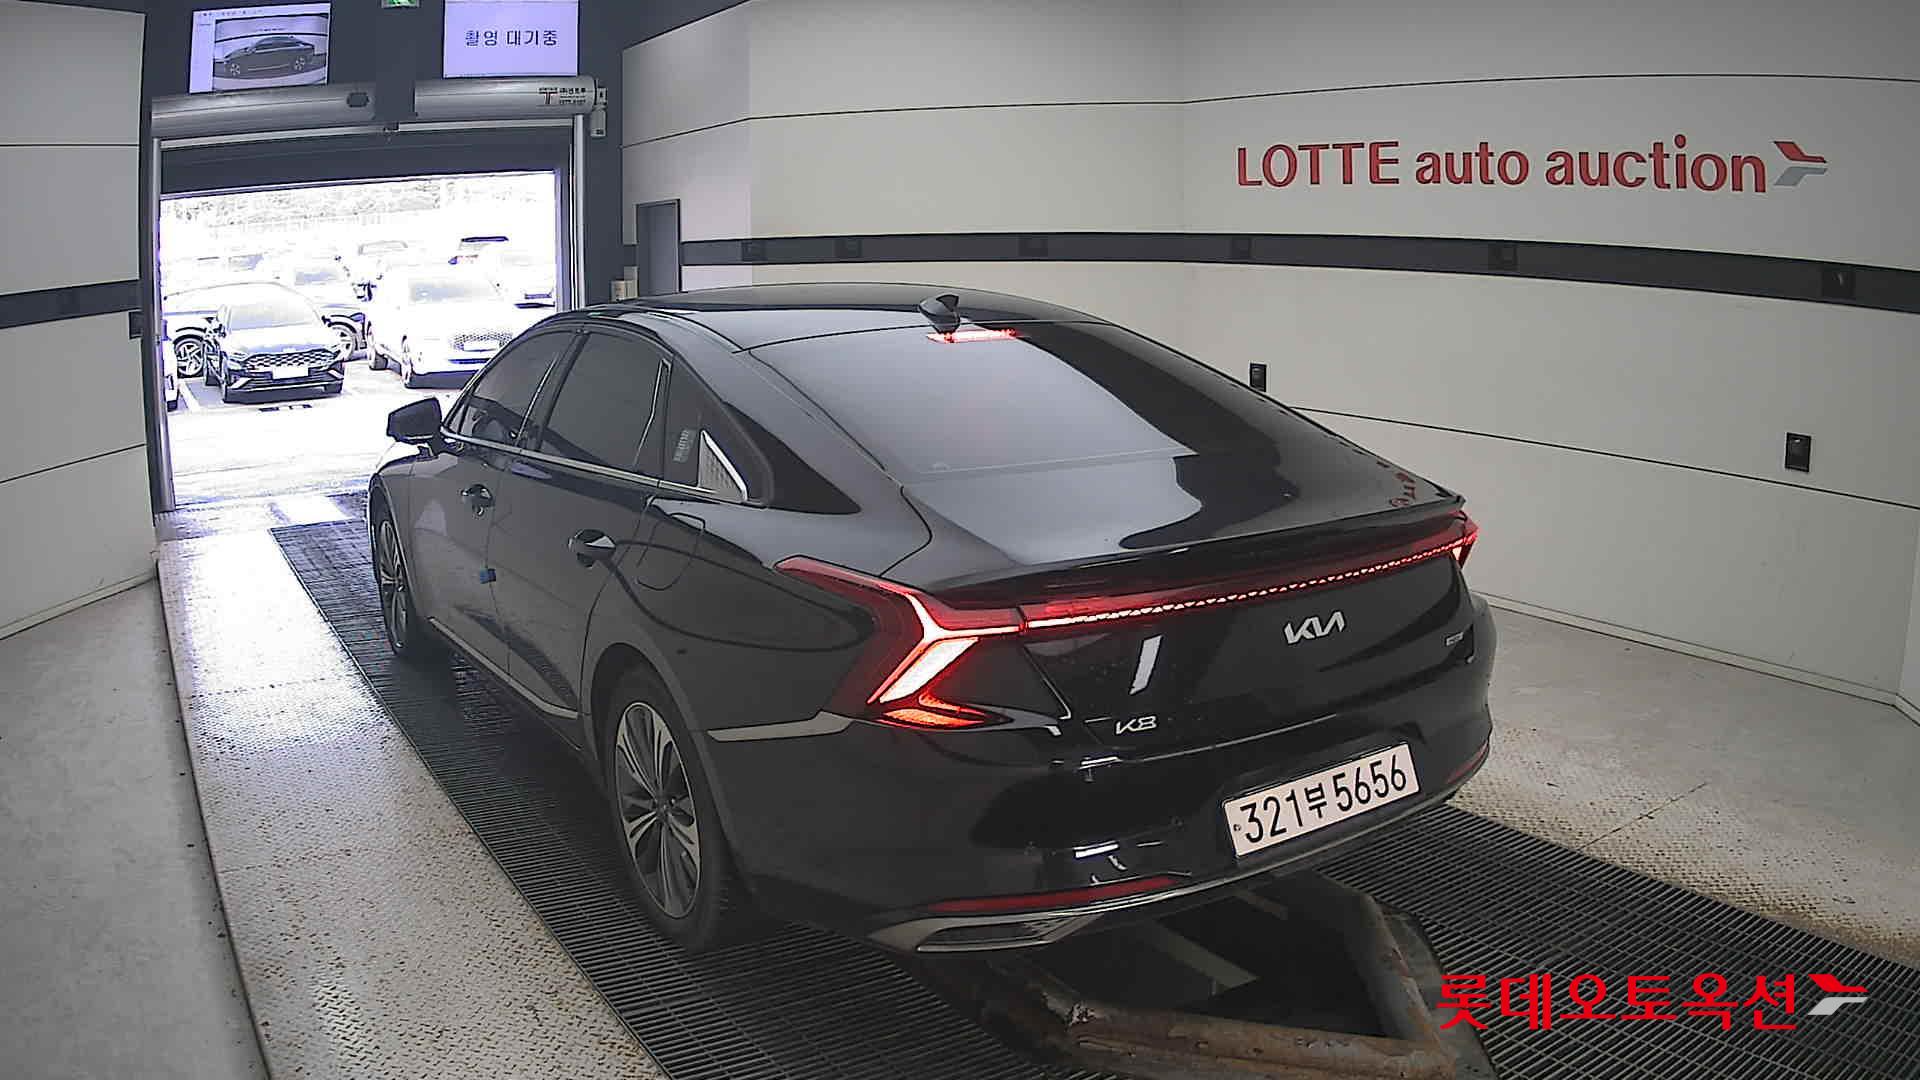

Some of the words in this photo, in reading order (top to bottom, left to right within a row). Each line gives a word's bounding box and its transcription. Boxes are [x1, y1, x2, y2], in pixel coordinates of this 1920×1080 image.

[465, 30, 498, 46] 촬영
[506, 30, 558, 46] 대기중
[1237, 141, 1400, 187] LOTTE
[1415, 142, 1530, 184] auto
[1545, 134, 1766, 193] auction
[1283, 611, 1346, 645] KIA
[1116, 716, 1157, 734] K8
